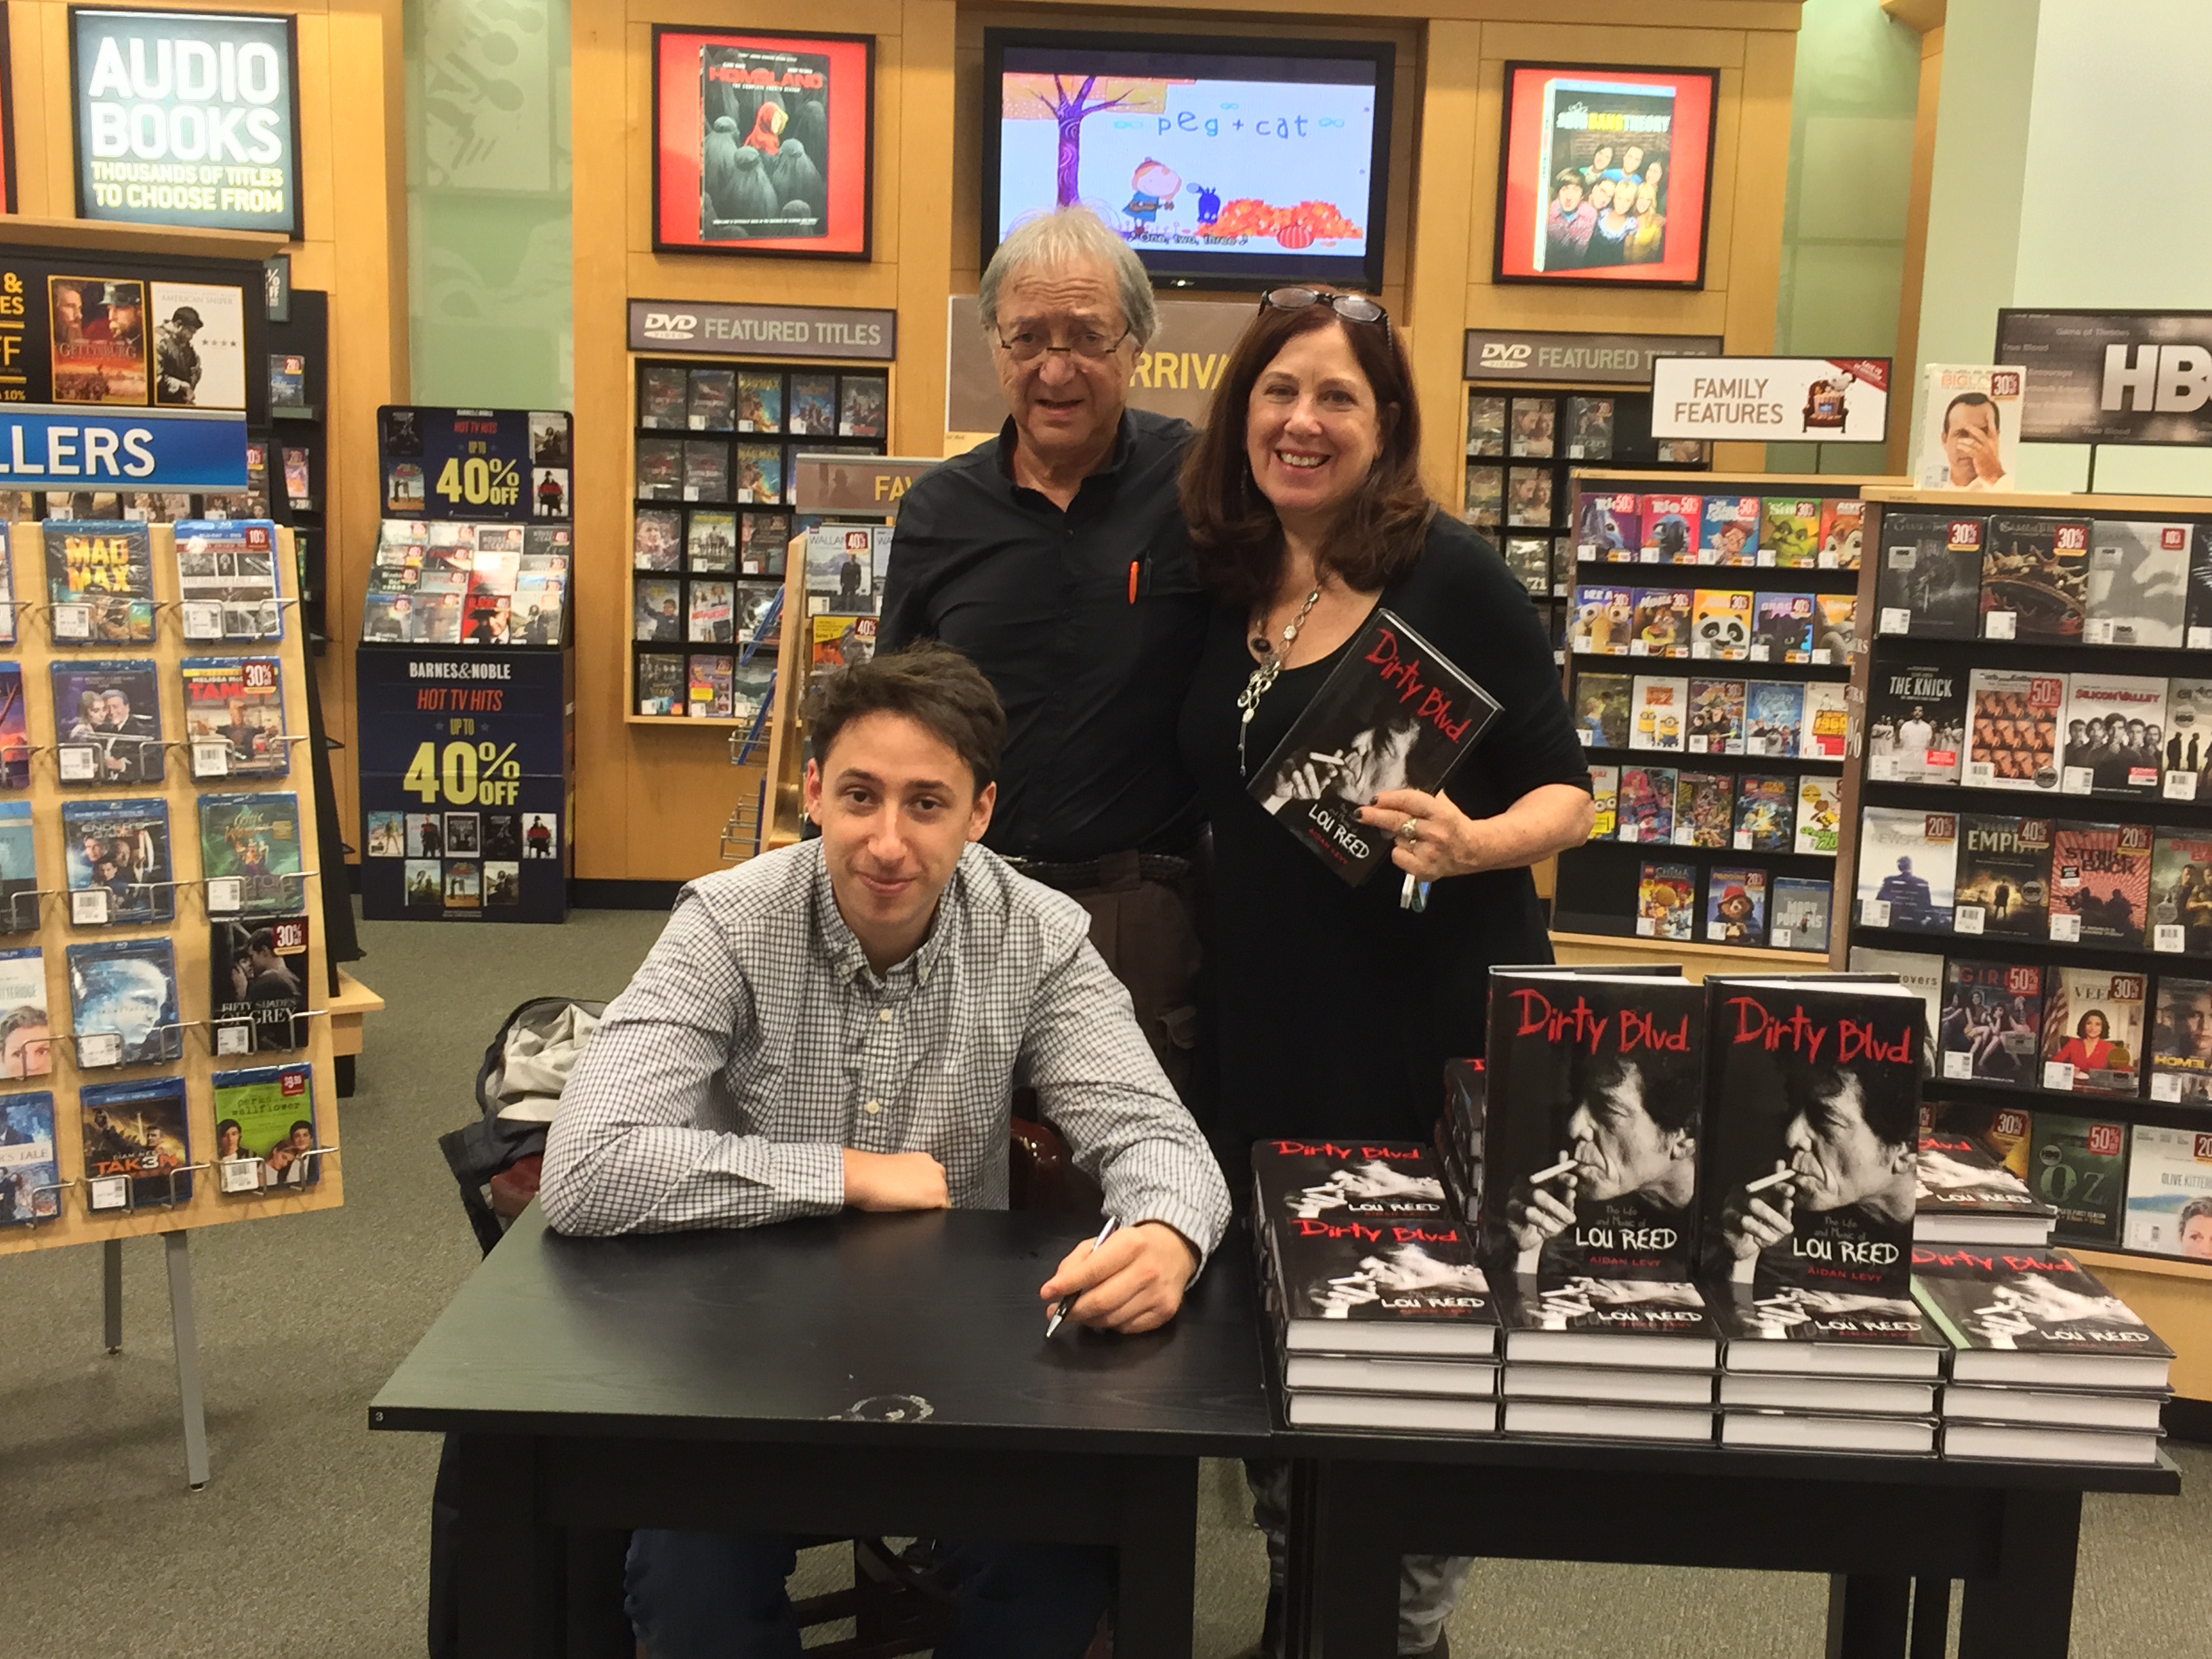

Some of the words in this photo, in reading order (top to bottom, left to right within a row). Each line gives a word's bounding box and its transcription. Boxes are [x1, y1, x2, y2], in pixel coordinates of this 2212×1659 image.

[89, 36, 281, 105] AUDIO
[709, 66, 823, 89] HOMELAND
[91, 102, 283, 163] BOOKS
[1158, 110, 1220, 137] peg
[1255, 114, 1309, 140] cat
[1588, 113, 1623, 131] BANG
[1622, 115, 1672, 132] THEORY
[90, 161, 197, 184] THOUSANDS
[199, 165, 224, 185] OF
[224, 166, 283, 187] TITLES
[93, 182, 123, 207] TO
[126, 184, 217, 211] CHOOSE
[221, 187, 284, 213] FROM
[4, 272, 23, 293] &
[644, 312, 697, 331] DVD
[705, 318, 809, 343] FEATURED
[815, 322, 881, 346] TITLES
[1481, 344, 1532, 360] DVD
[1538, 346, 1639, 370] FEATURED
[1694, 377, 1769, 400] FAMILY
[2101, 343, 2212, 413] HB
[1673, 402, 1784, 424] FEATURES
[0, 425, 156, 477] LERS
[436, 457, 520, 505] 40%
[489, 486, 520, 506] OFF
[2057, 526, 2086, 549] 30%
[64, 536, 129, 567] MAD
[66, 564, 131, 593] MAX
[1364, 628, 1426, 704] Dirty
[1889, 676, 1912, 695] THE
[1913, 677, 1953, 698] KNICK
[2032, 680, 2060, 703] 50%
[417, 688, 447, 711] HOT
[450, 689, 469, 711] TV
[470, 689, 504, 712] HITS
[450, 718, 464, 735] UP
[464, 718, 475, 735] TO
[403, 741, 520, 805] 40%
[479, 780, 520, 806] OFF
[1308, 804, 1336, 833] LOU
[1332, 823, 1370, 859] REED
[276, 923, 302, 947] 30%
[2010, 968, 2039, 991] 50%
[2113, 979, 2139, 999] 30%
[249, 1007, 297, 1025] GREY
[1509, 988, 1609, 1055] Dirty
[1724, 996, 1829, 1065] Dirty
[230, 1101, 304, 1117] wallflower
[1998, 1113, 2023, 1136] 30%
[1269, 1140, 1352, 1160] Dirty
[2091, 1126, 2119, 1151] 50%
[92, 1153, 179, 1176] TAK3N
[2161, 1172, 2183, 1187] OLIVE
[1348, 1203, 1385, 1212] LOU
[1390, 1203, 1441, 1212] REED
[1290, 1219, 1382, 1244] Dirty
[1576, 1226, 1614, 1249] LOU
[1618, 1227, 1678, 1251] REED
[1589, 1256, 1627, 1265] AIDAN
[1793, 1237, 1832, 1261] LOU
[1837, 1240, 1900, 1266] REED
[1807, 1267, 1847, 1279] AIDAN
[1850, 1272, 1883, 1283] LEVY
[1381, 1298, 1422, 1309] LOU
[1427, 1297, 1486, 1309] REED
[1597, 1311, 1639, 1322] LOU
[1644, 1311, 1703, 1322] REED
[1814, 1320, 1858, 1332] LOU
[1861, 1322, 1923, 1332] REED
[2041, 1329, 2087, 1343] LOU
[2089, 1331, 2151, 1344] REED
